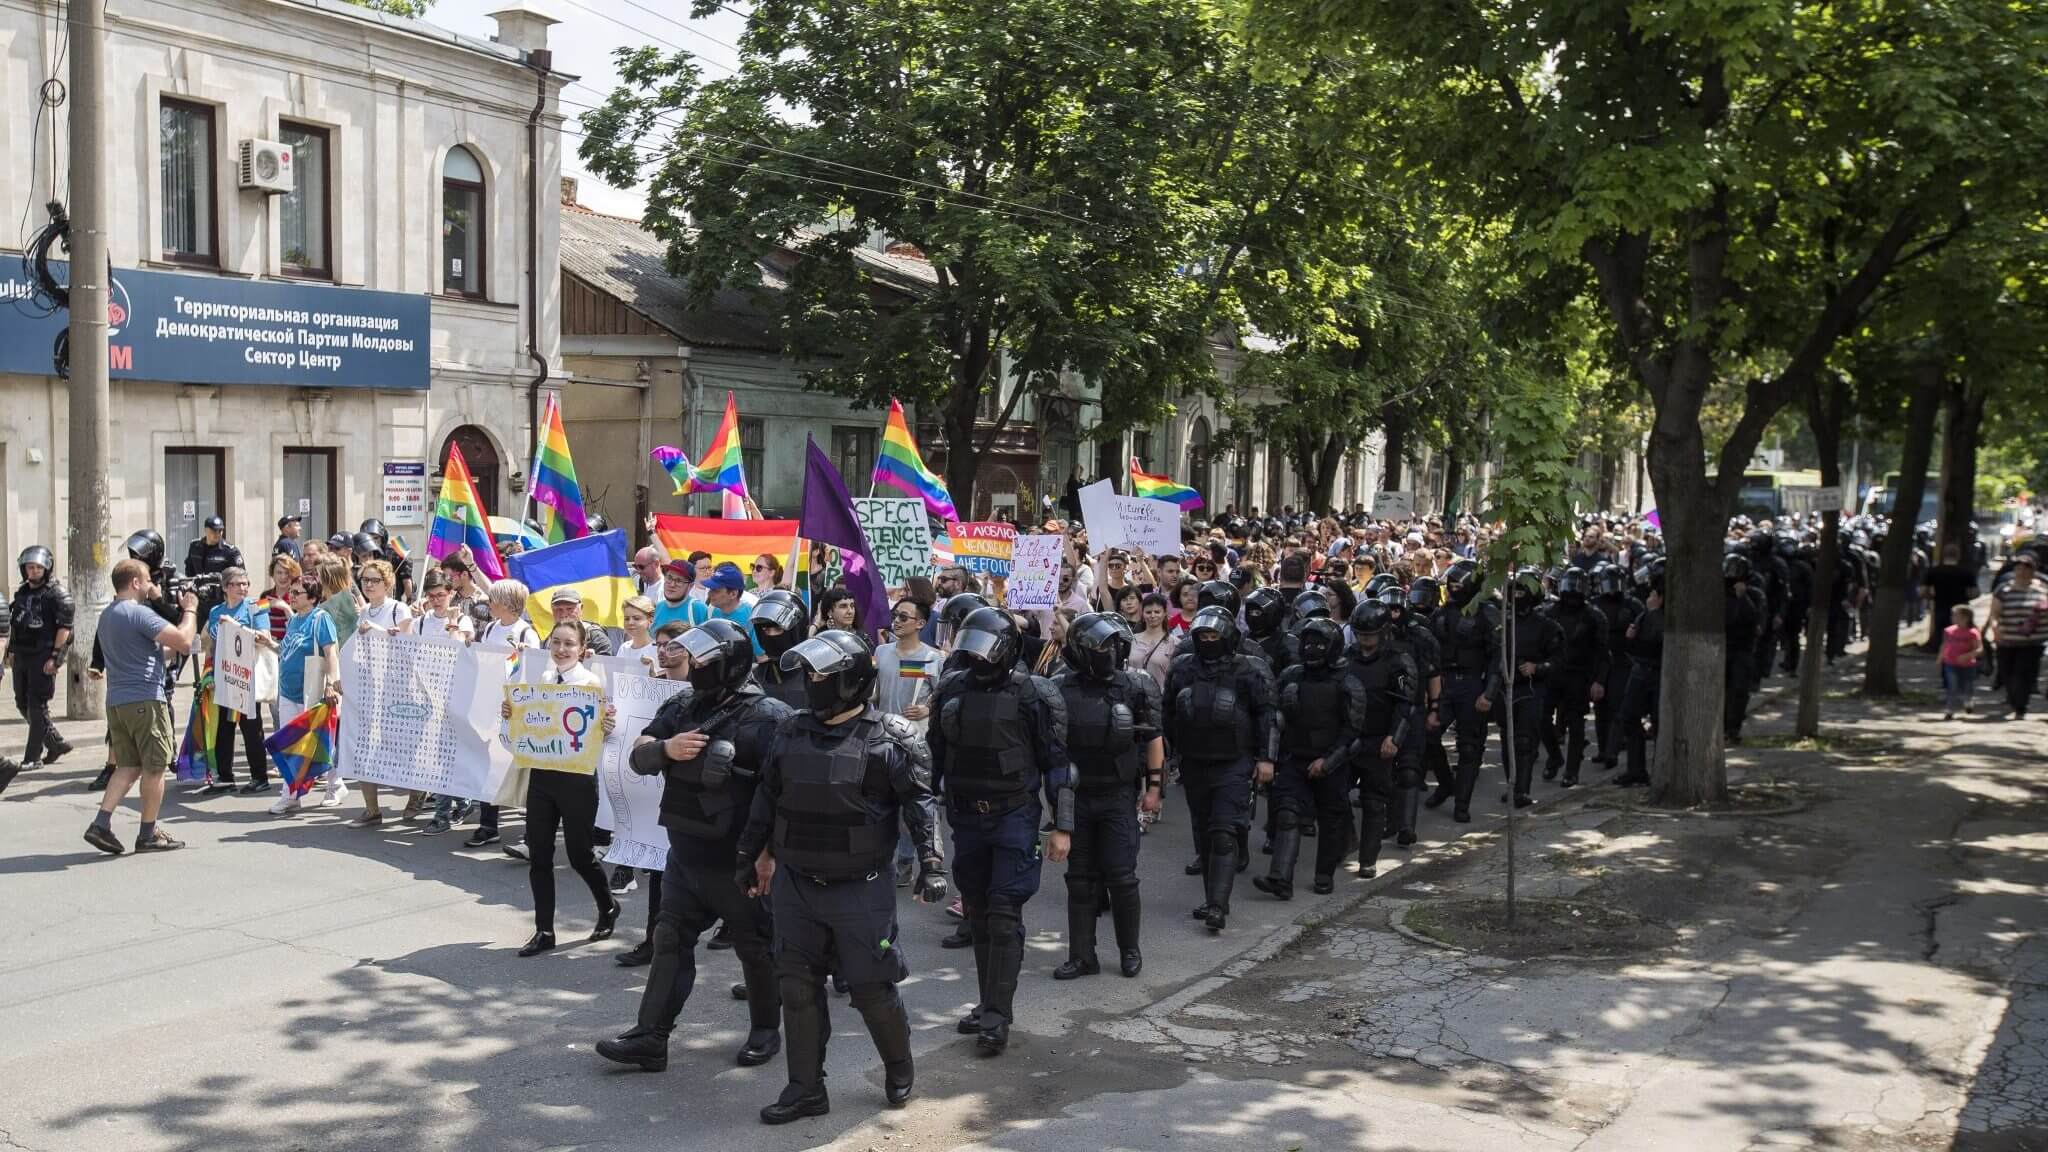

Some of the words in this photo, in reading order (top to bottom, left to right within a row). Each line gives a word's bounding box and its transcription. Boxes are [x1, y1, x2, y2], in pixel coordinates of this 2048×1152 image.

[174, 296, 309, 323] Территориальная
[313, 312, 399, 332] организация
[156, 317, 294, 344] Демократической
[298, 329, 349, 349] Партии
[352, 333, 414, 352] Молдовы
[245, 346, 296, 369] Сектор
[300, 350, 341, 371] Центр
[854, 500, 921, 524] SPECT
[862, 526, 927, 545] STENCE
[956, 525, 967, 537] Я
[973, 525, 1014, 539] ЛЮБЛЮ
[872, 545, 929, 563] PECT
[512, 687, 535, 703] Sunt
[526, 711, 551, 724] dintre
